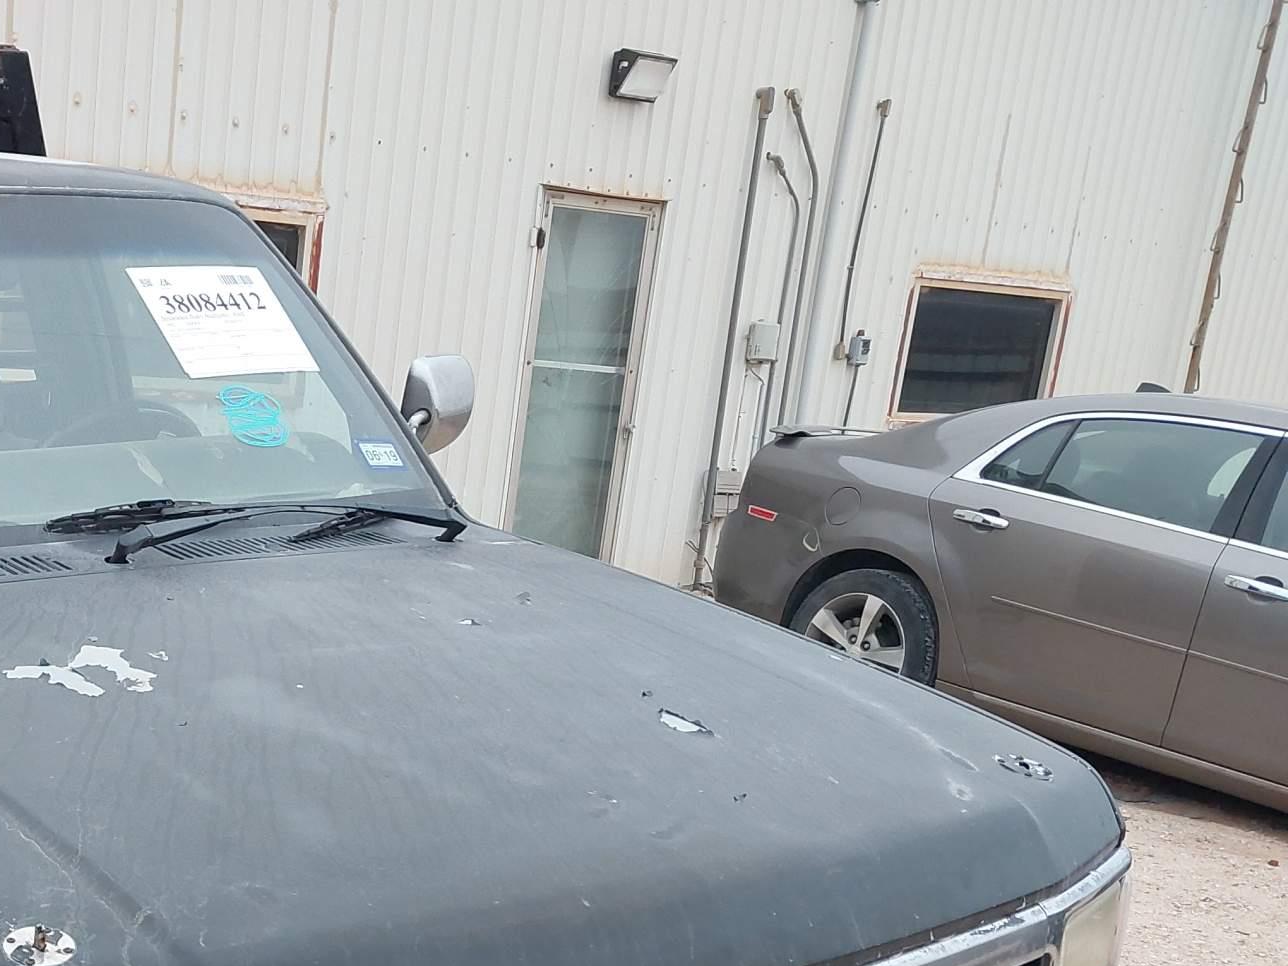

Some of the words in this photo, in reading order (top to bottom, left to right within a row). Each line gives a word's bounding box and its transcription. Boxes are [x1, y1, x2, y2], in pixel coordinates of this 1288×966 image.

[159, 291, 266, 314] 38084412
[365, 450, 381, 461] 06
[384, 450, 398, 461] 19
